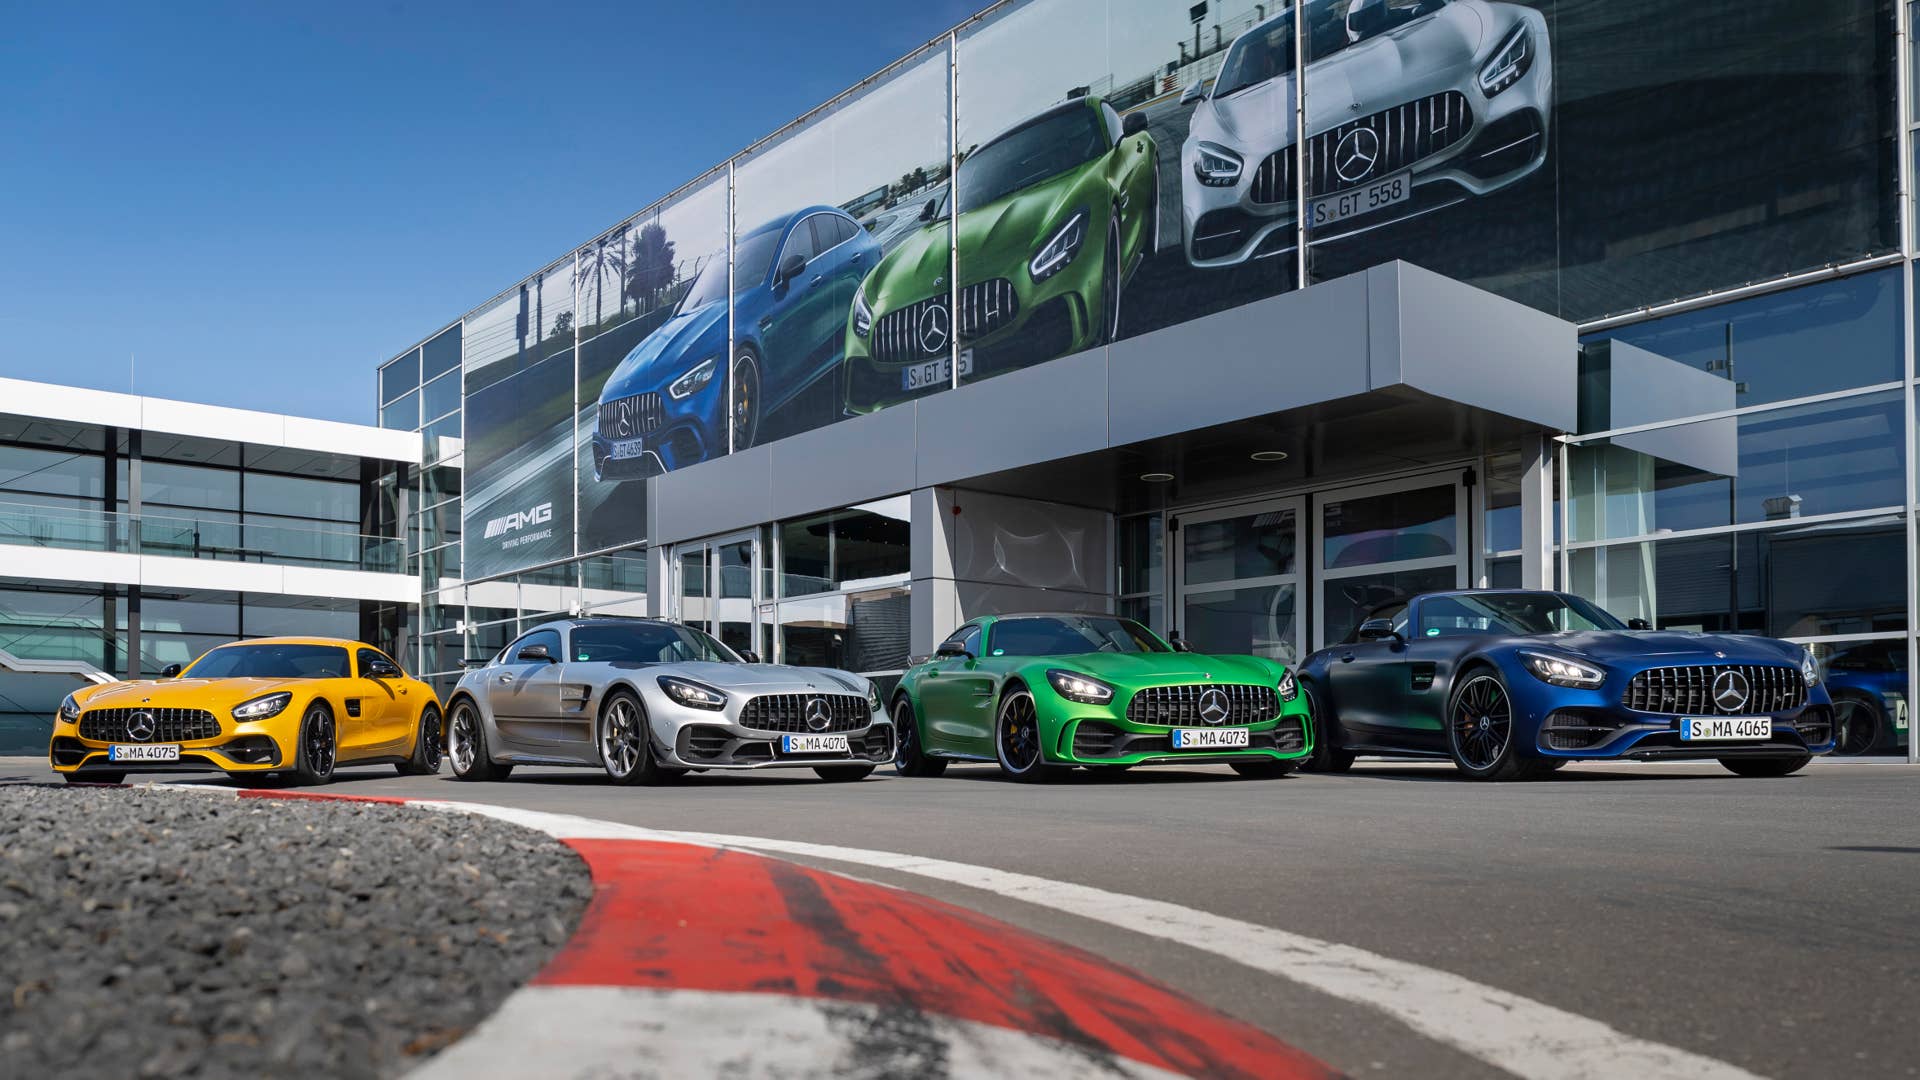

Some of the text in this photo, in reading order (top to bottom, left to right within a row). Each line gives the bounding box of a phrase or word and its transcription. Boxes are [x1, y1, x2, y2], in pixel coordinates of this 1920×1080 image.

[1315, 179, 1402, 222] S GT 558
[909, 353, 967, 387] S GT 55
[503, 502, 552, 534] AMG
[520, 529, 552, 545] PERFORMANCE
[1692, 720, 1769, 737] S MA 4065
[791, 737, 846, 751] S MA 4070
[1182, 731, 1247, 745] S MA 4073
[116, 747, 177, 759] S MA 4075
